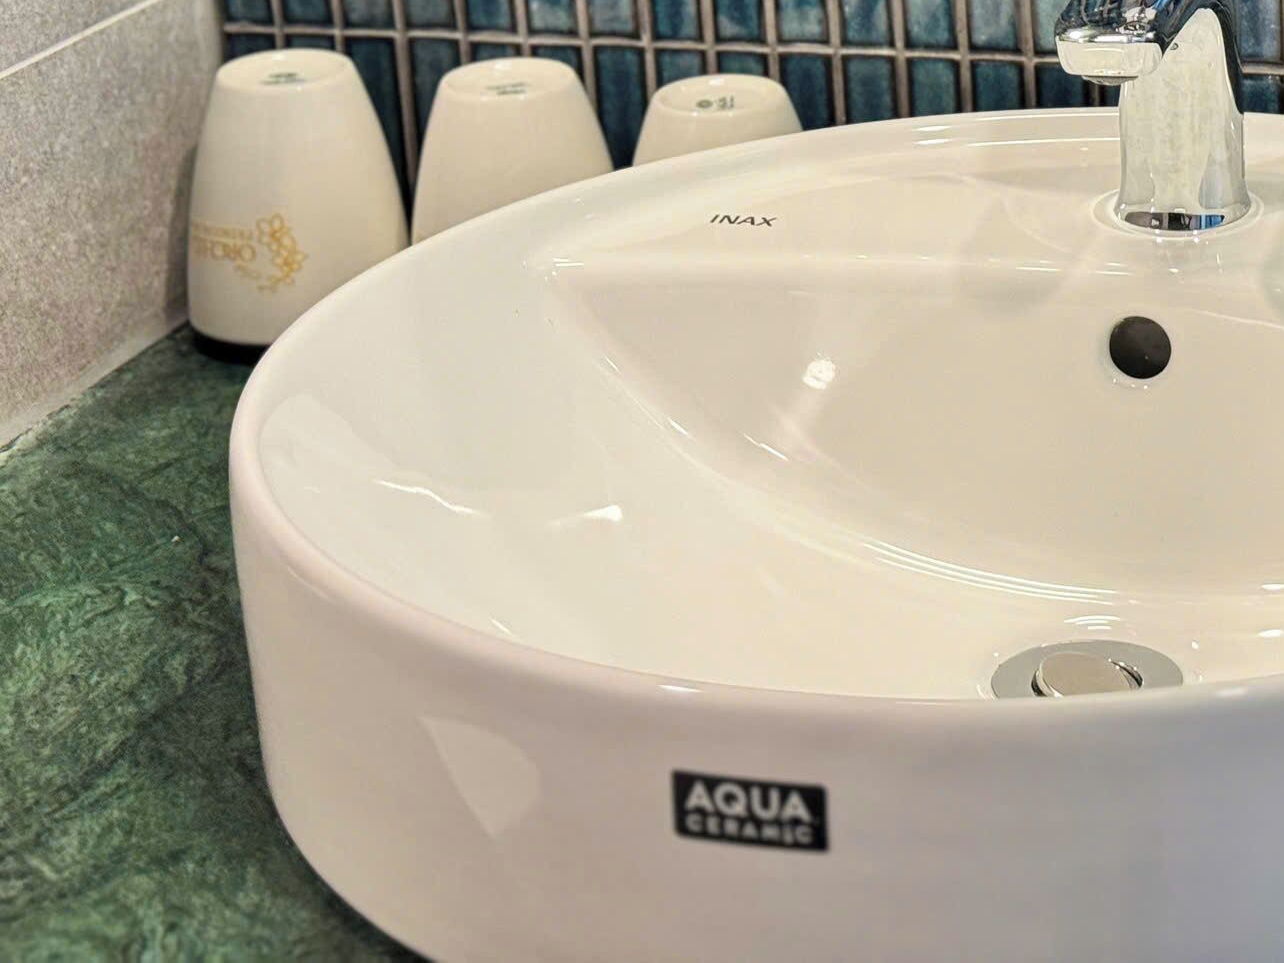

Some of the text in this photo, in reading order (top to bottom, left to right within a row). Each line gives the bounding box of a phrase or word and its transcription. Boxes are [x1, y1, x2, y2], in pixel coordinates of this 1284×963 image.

[709, 214, 778, 227] INAX
[684, 780, 813, 824] AQUA
[685, 812, 814, 845] CERAMIC
